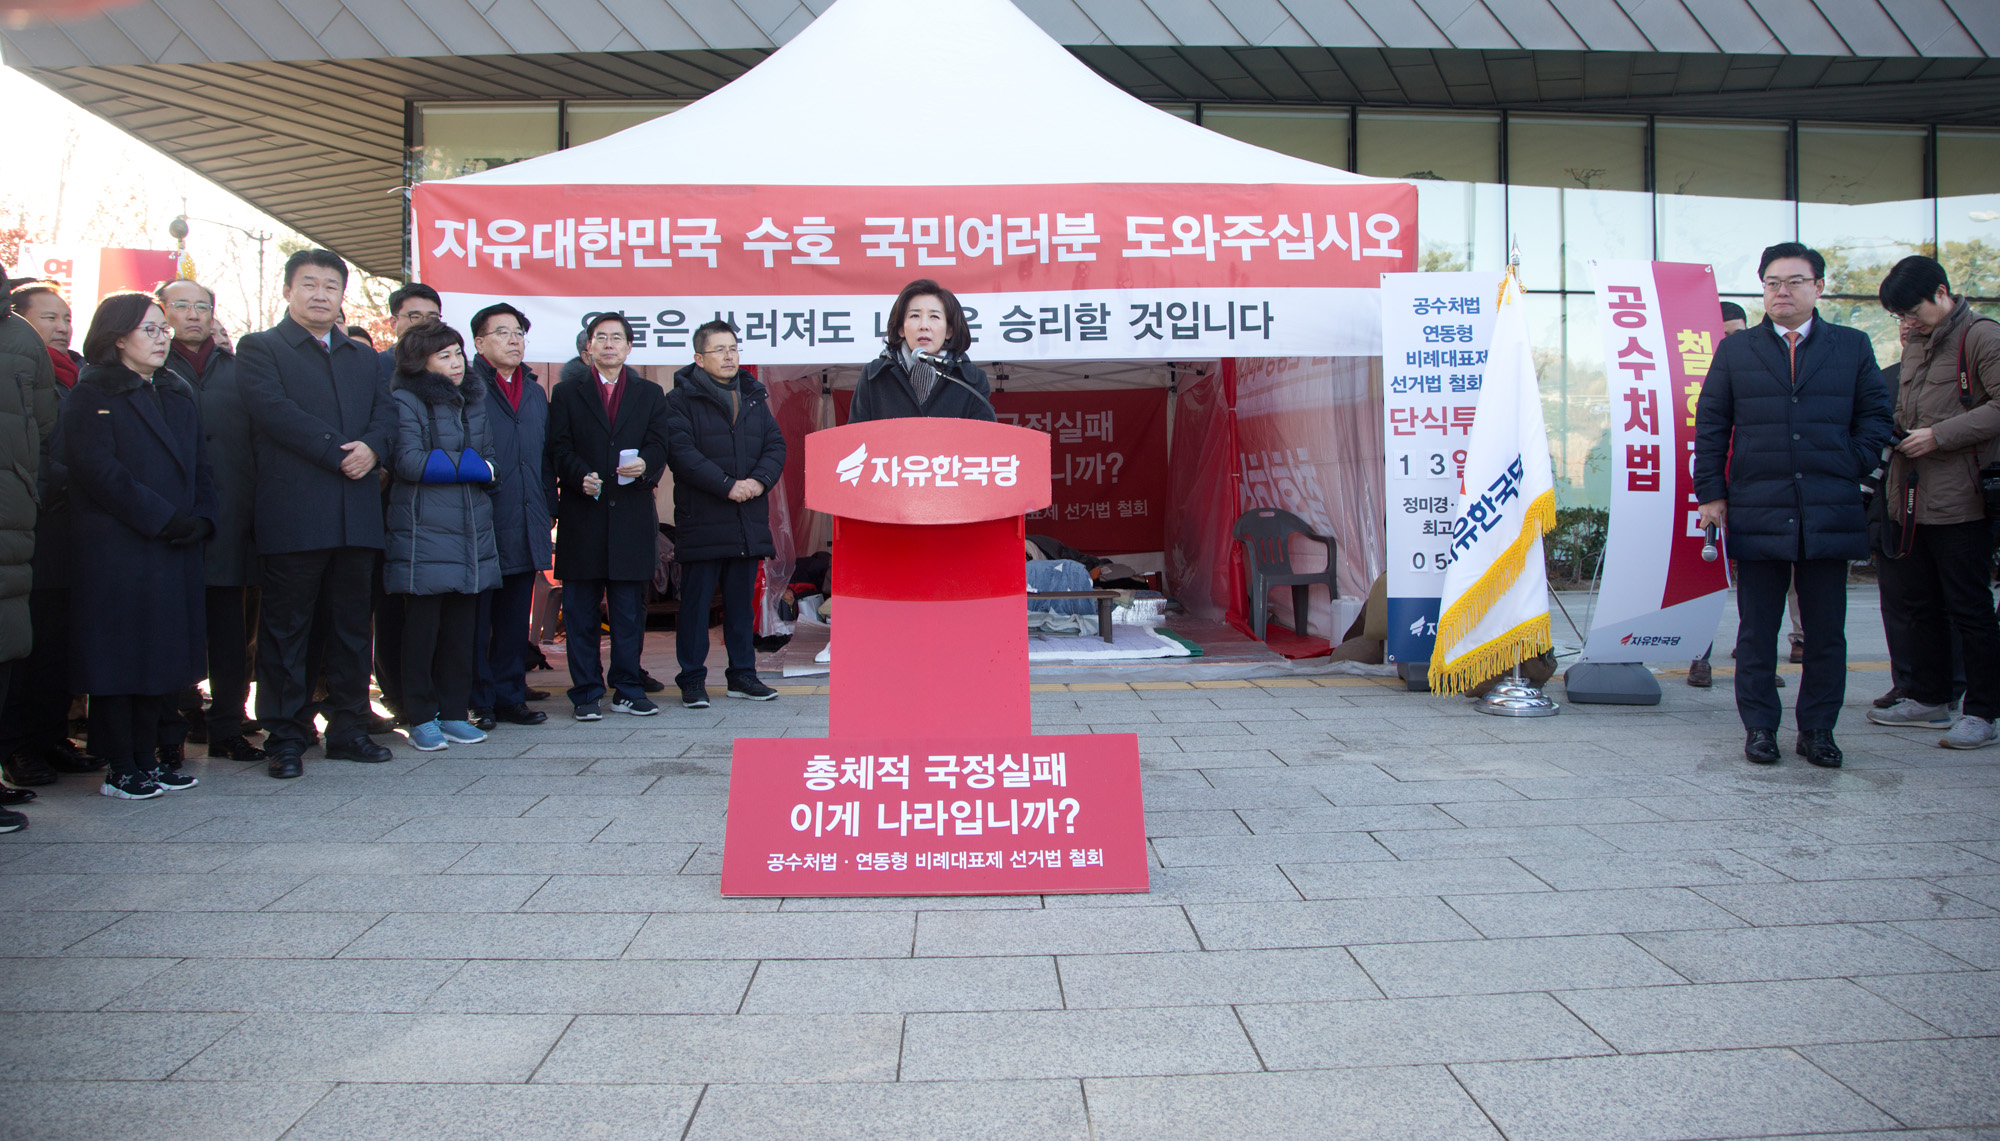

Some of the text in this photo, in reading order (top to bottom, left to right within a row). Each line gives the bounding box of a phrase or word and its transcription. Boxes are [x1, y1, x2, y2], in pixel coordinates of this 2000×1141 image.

[432, 211, 1402, 269] 자유대한민국 수호 국민여러분 도와주십시오
[1412, 296, 1481, 316] 공수처법
[999, 302, 1111, 342] 승리할
[1128, 301, 1274, 341] 것입니다
[1422, 324, 1474, 343] 연동형
[1390, 374, 1483, 393] 선거법 철회
[1607, 285, 1660, 492] 공수처법
[870, 454, 1021, 487] 자유한국당
[1064, 502, 1111, 520] 선거법
[1117, 499, 1149, 518] 철회
[1906, 488, 1915, 514] Canon
[1630, 636, 1681, 646] 자유한국당
[803, 752, 1067, 791] 총체적 국정실패
[790, 797, 1081, 838] 이게 나라입니까?
[767, 852, 838, 872] 공수처법
[855, 851, 909, 871] 연동형
[915, 850, 1003, 870] 비례대표제
[1009, 849, 1063, 869] 선거법
[1068, 848, 1105, 867] 철회
